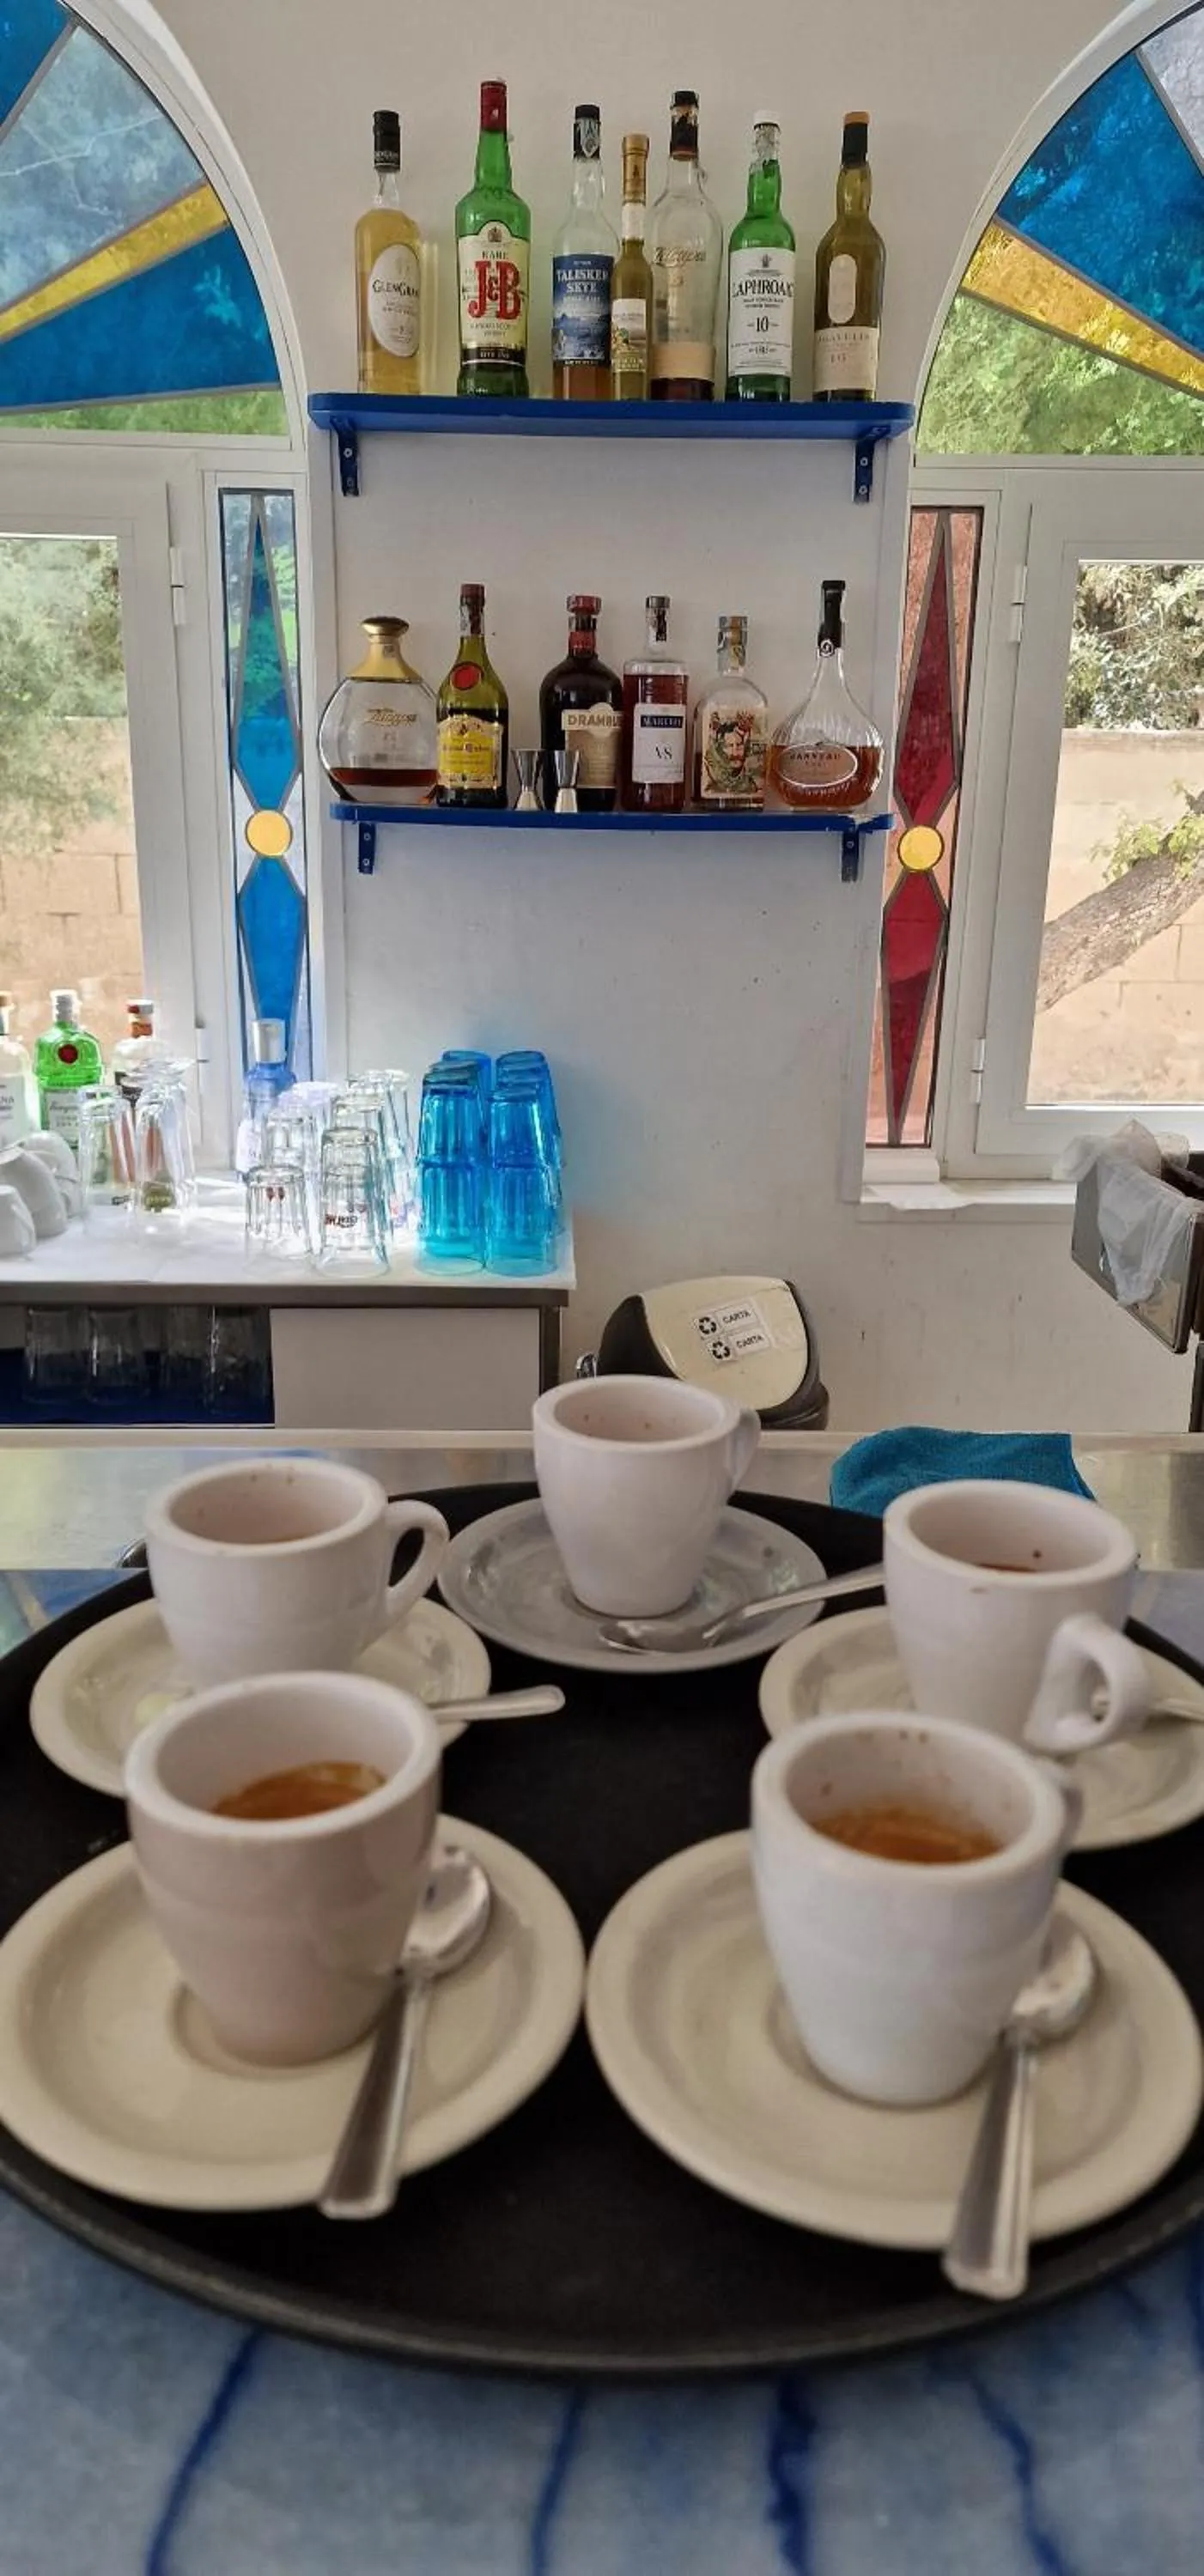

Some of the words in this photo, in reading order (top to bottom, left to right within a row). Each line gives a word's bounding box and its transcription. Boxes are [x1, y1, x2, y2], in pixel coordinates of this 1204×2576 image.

[566, 283, 598, 293] SKYE
[756, 315, 769, 332] 10
[722, 1310, 751, 1323] CARTA
[736, 1334, 763, 1349] CARTA
